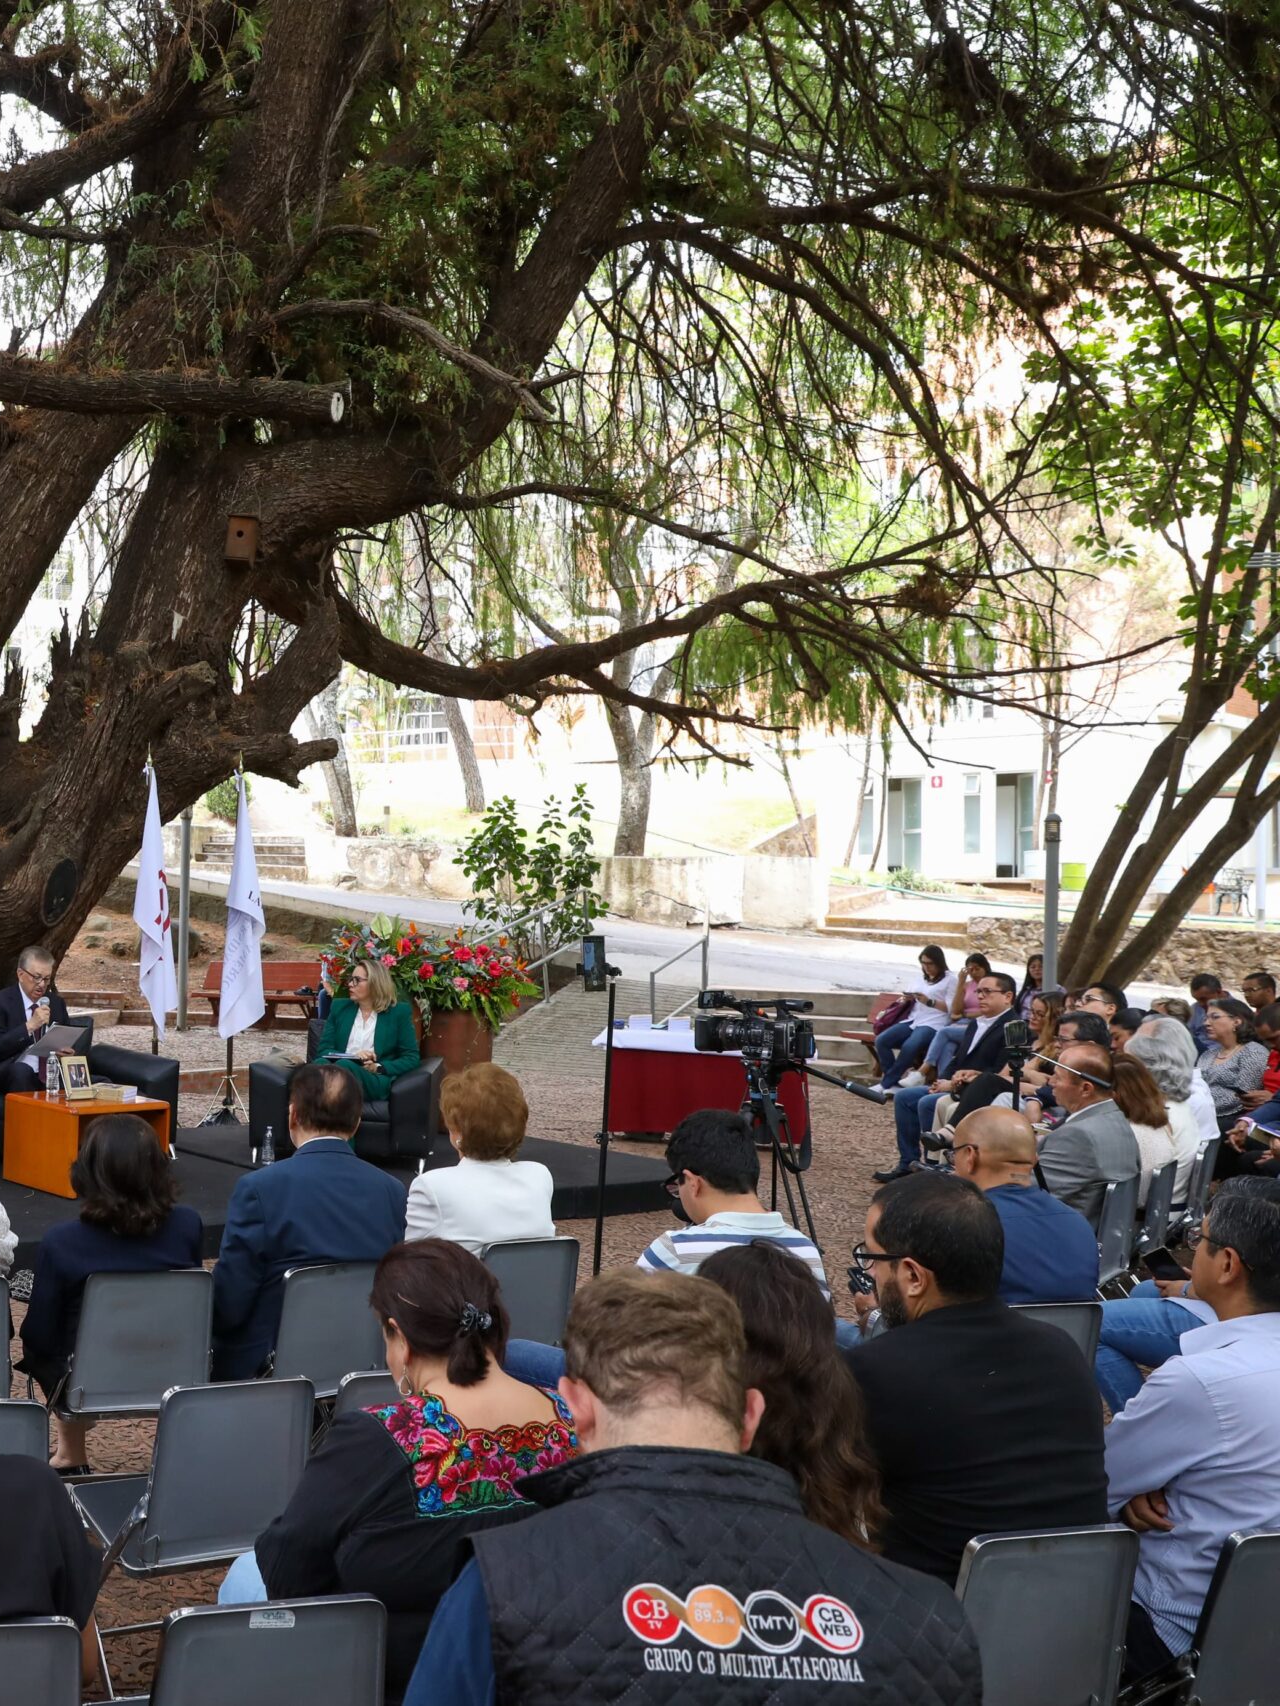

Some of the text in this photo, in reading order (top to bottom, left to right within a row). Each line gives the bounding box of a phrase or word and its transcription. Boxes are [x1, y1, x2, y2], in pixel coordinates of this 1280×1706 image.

[632, 1599, 670, 1620] CB
[694, 1607, 724, 1624] 89.3
[818, 1607, 845, 1623] CB
[647, 1619, 662, 1629] TV
[749, 1615, 796, 1631] TMTV
[819, 1622, 853, 1637] WEB
[644, 1647, 865, 1682] GRUPO CB MULTIPLATAFORMA
